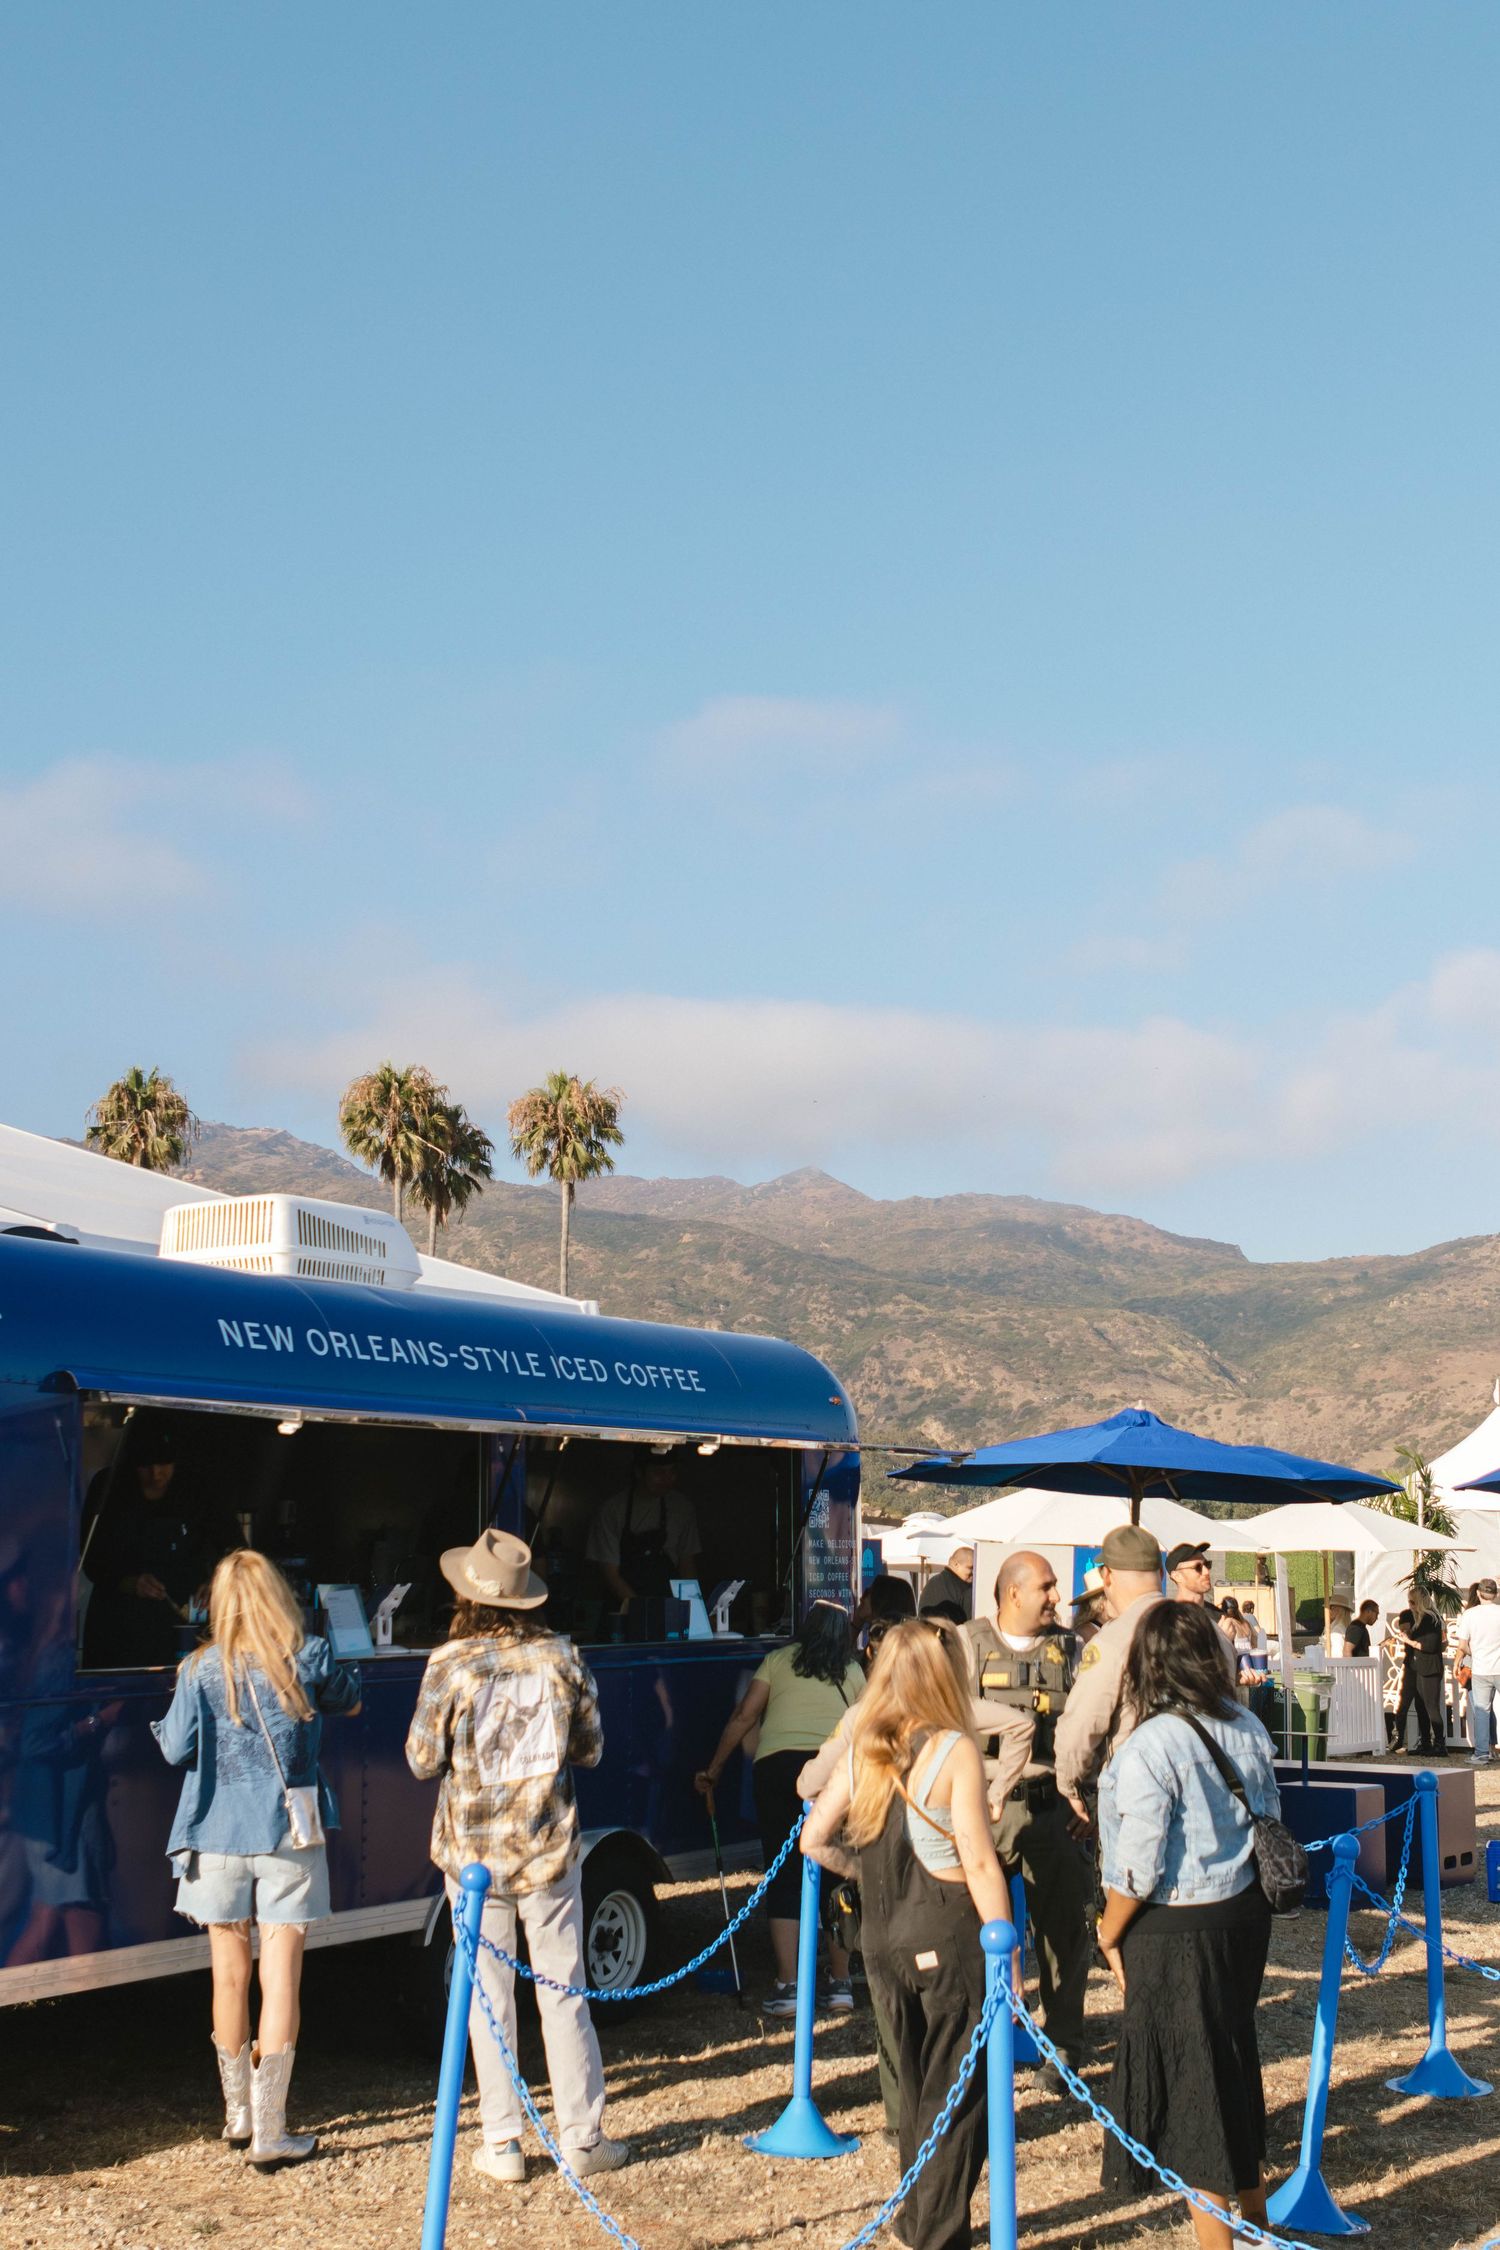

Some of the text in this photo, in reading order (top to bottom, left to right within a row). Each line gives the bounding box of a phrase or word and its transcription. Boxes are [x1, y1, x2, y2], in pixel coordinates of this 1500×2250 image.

[217, 1318, 706, 1392] NEW ORLEANS-STYLE ICED COFFEE
[809, 1540, 824, 1549] MAKE
[809, 1556, 821, 1565] NEW
[809, 1572, 849, 1582] ICED COFFEE
[809, 1589, 836, 1598] SECONDS
